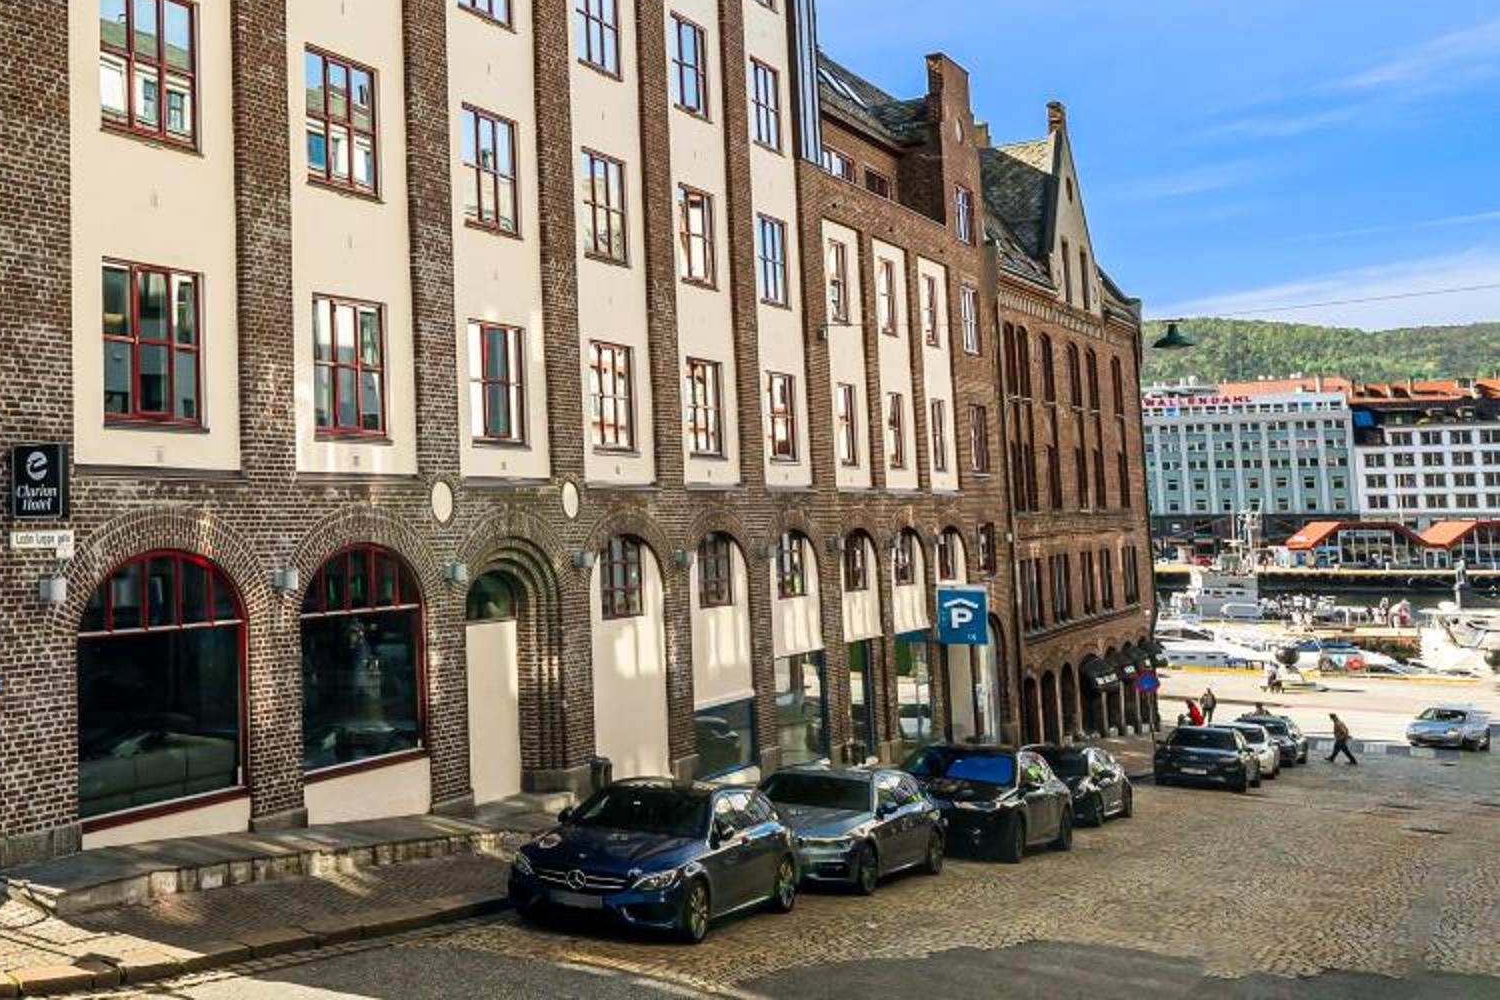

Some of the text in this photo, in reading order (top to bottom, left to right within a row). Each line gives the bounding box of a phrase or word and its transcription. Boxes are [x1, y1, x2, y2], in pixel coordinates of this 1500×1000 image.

[17, 483, 57, 498] Clarion
[22, 497, 52, 511] Hotel
[951, 607, 973, 629] P
